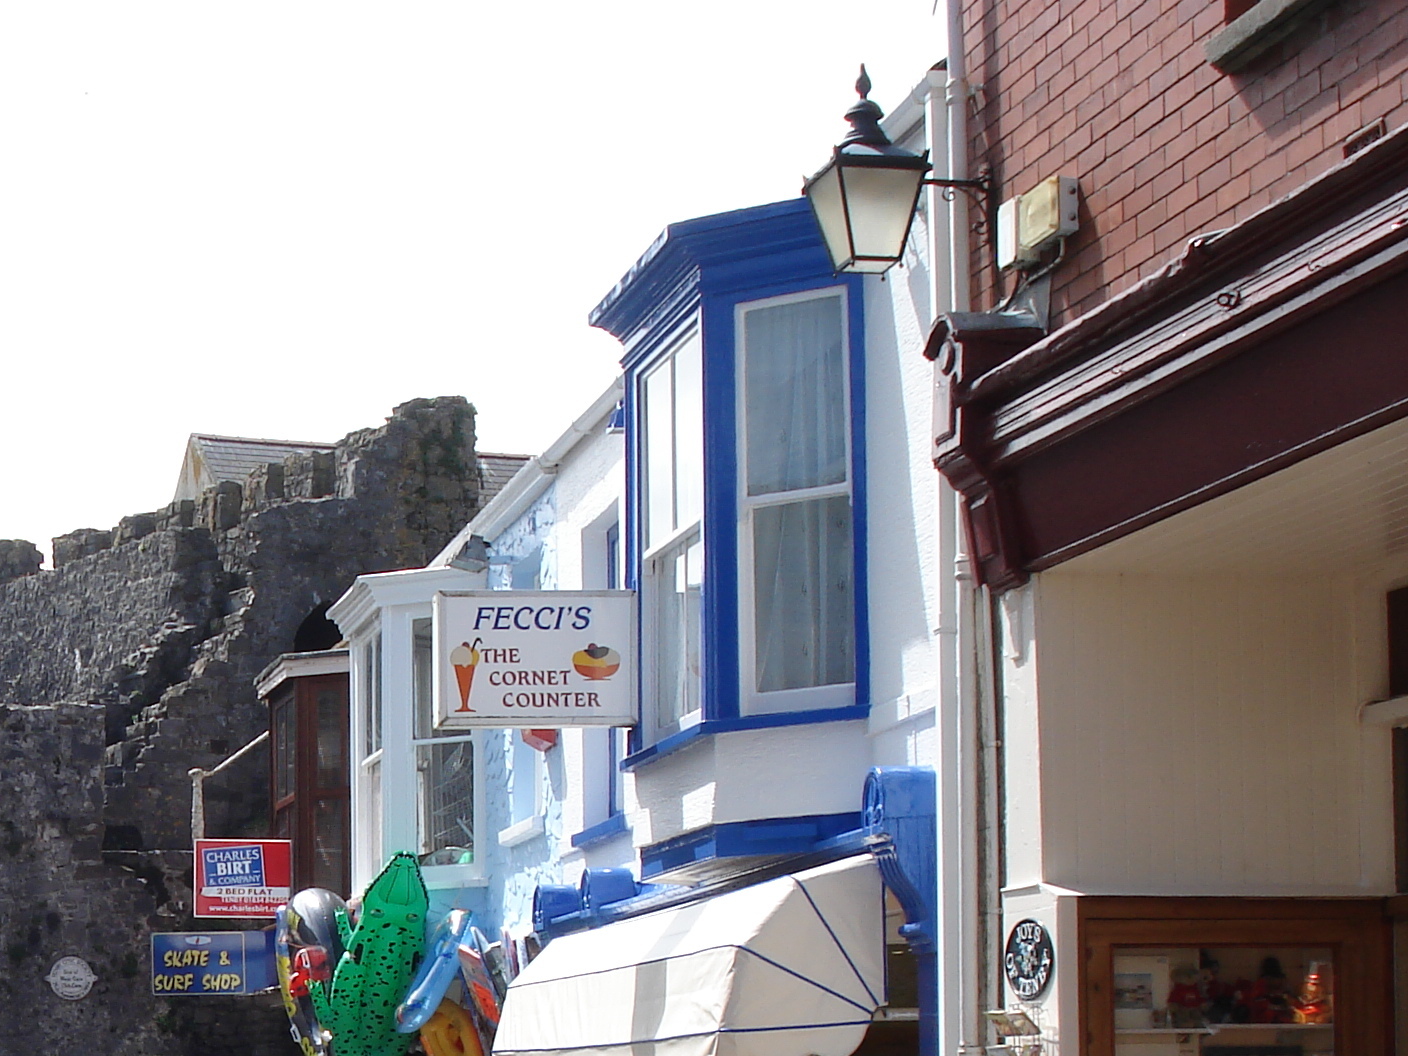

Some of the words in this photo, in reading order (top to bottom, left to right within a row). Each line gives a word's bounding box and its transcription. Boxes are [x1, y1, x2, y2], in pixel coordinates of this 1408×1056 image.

[473, 606, 592, 630] FECCI'S
[481, 648, 520, 664] THE
[489, 670, 572, 686] CORNET
[502, 692, 601, 708] COUNTER
[206, 849, 260, 863] CHARLES
[216, 861, 252, 876] BIRT
[218, 875, 261, 885] COMPANY
[1016, 923, 1042, 943] JOYS
[164, 949, 209, 967] SKATE
[219, 950, 231, 966] &
[154, 973, 193, 991] SURF
[202, 973, 241, 991] SHOP
